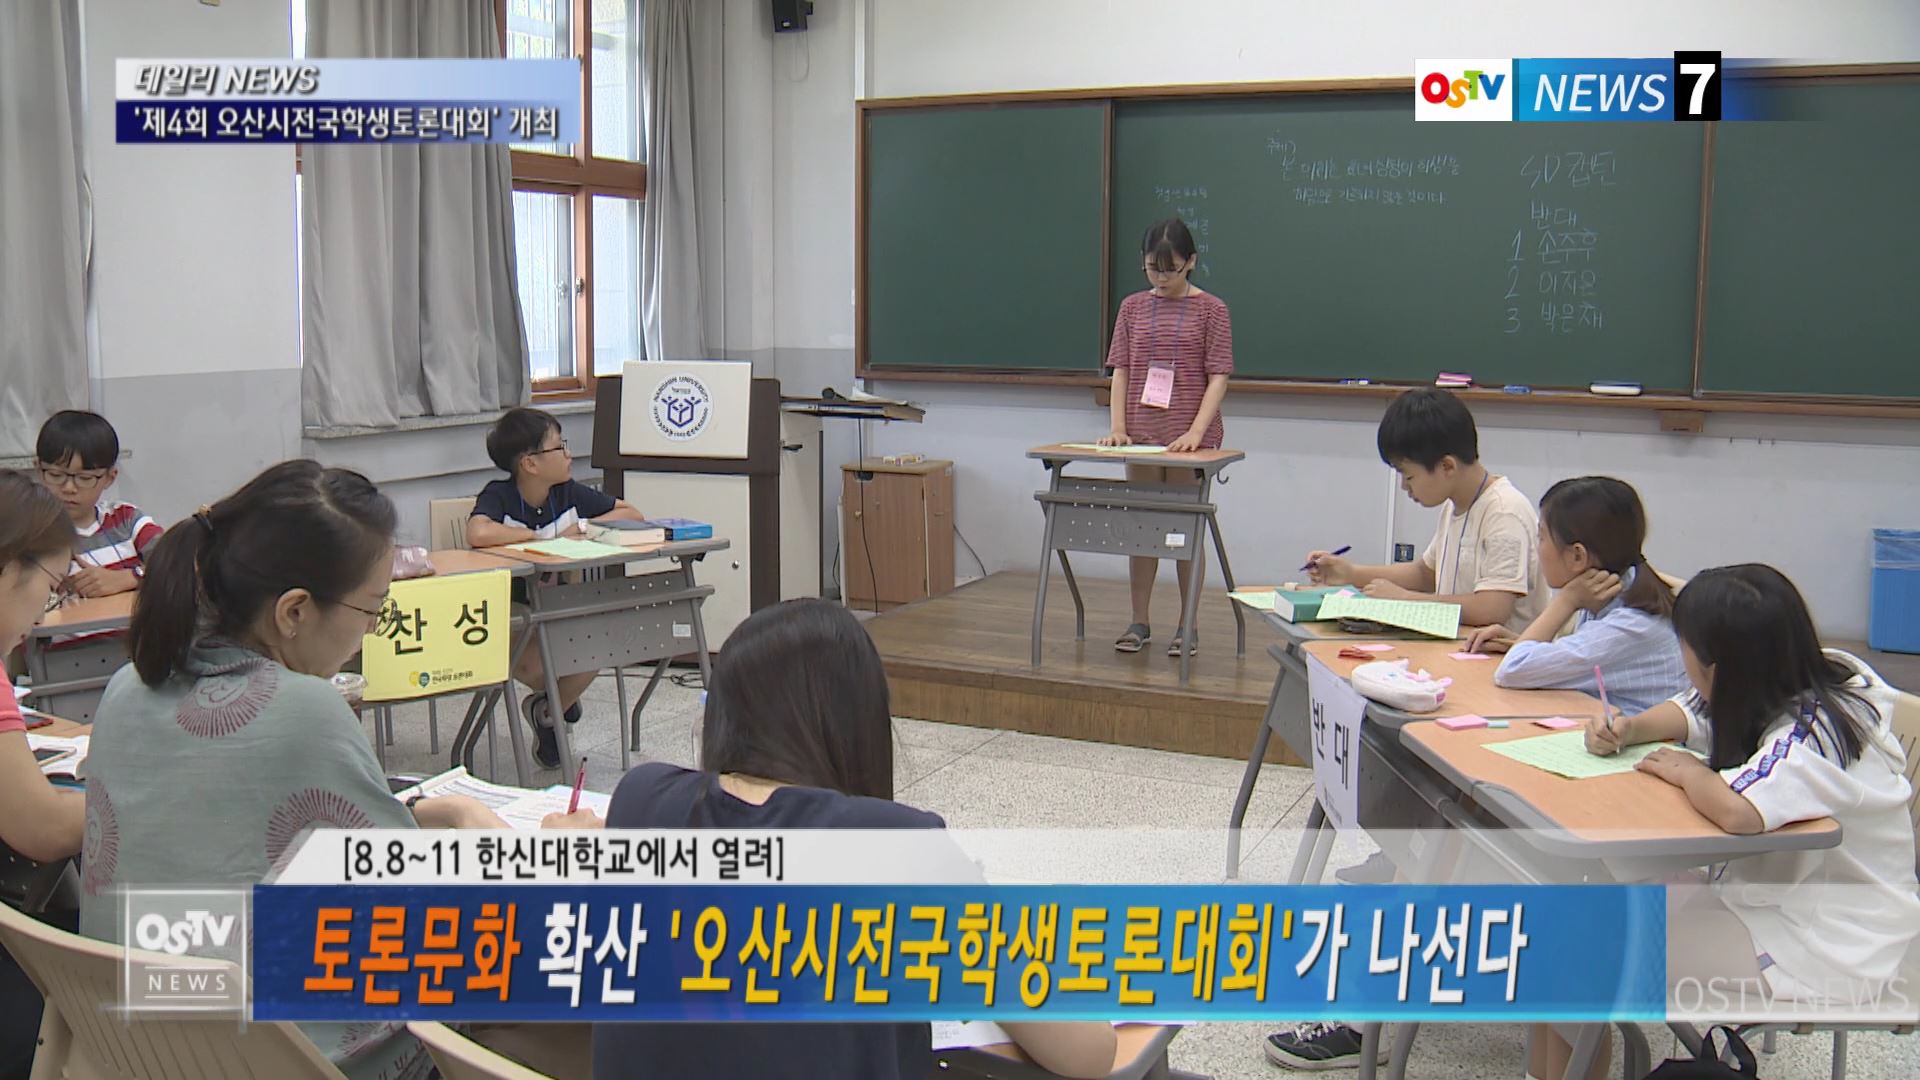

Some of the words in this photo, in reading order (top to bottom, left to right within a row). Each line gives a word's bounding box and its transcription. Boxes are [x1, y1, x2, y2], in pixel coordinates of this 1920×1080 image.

[1531, 200, 1577, 230] 반대
[1507, 228, 1525, 262] 1
[1504, 264, 1521, 300] 2
[1503, 306, 1521, 334] 3
